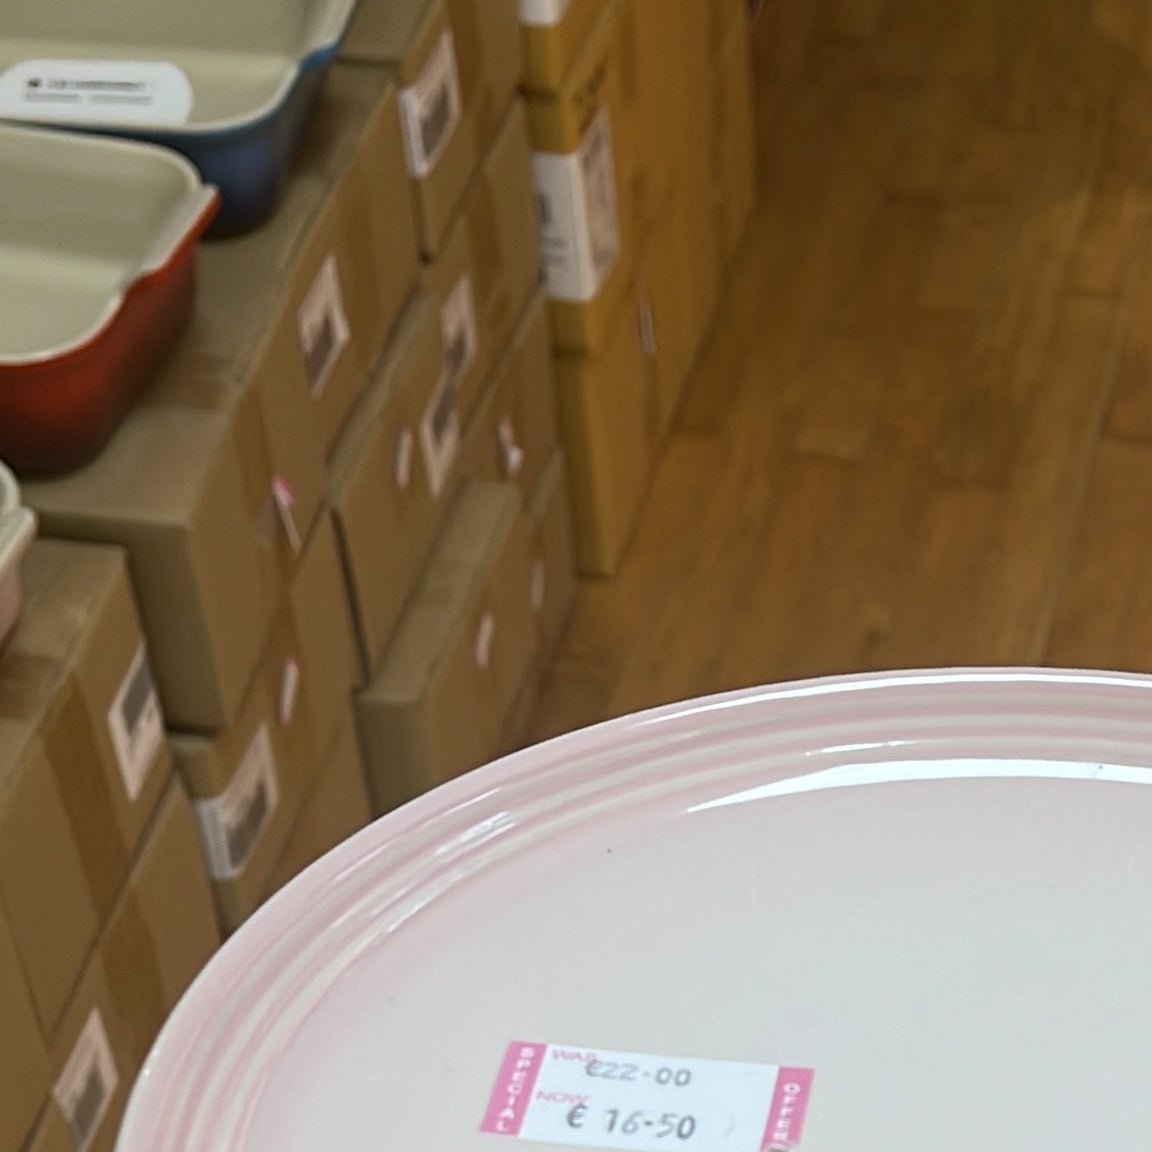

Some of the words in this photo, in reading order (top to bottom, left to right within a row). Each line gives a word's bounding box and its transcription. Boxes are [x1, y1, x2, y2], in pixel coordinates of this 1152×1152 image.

[551, 1049, 598, 1065] WAS
[496, 1046, 536, 1133] SPECIAL
[536, 1089, 589, 1105] NOW
